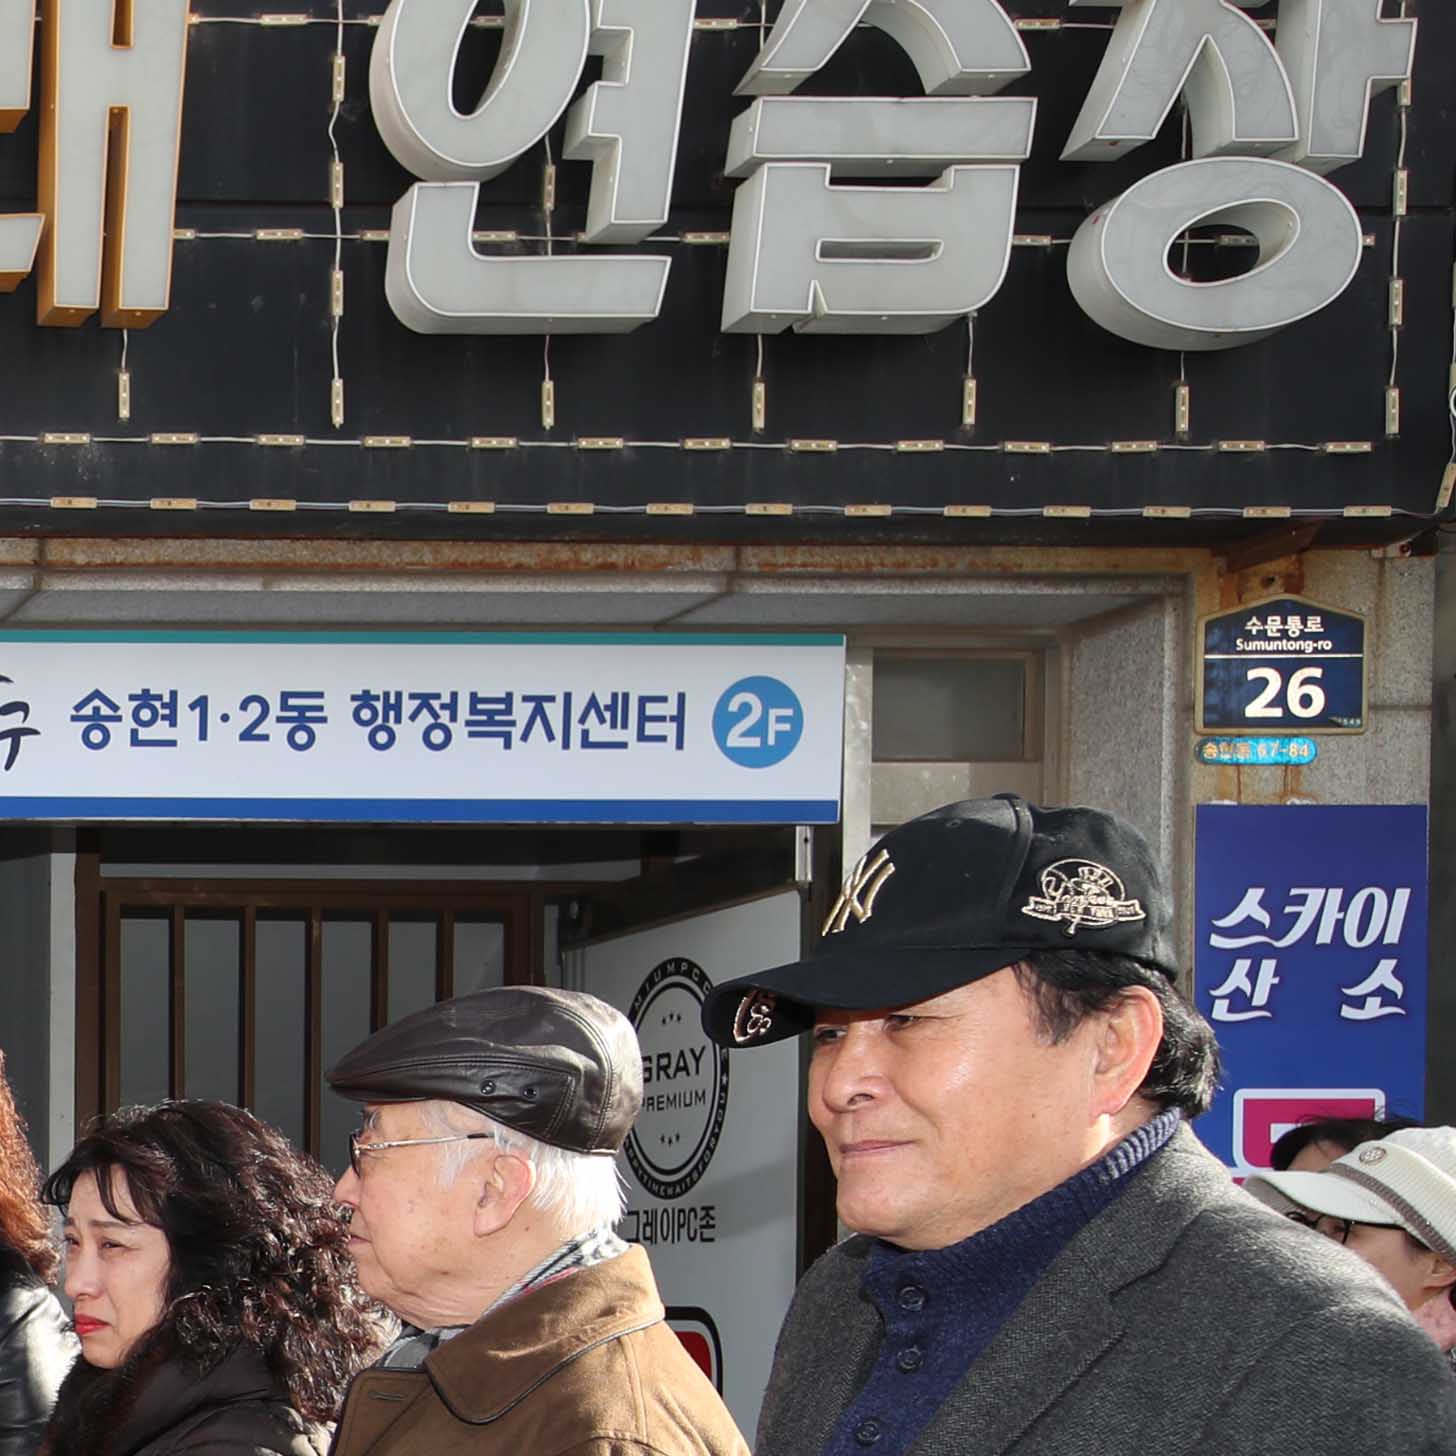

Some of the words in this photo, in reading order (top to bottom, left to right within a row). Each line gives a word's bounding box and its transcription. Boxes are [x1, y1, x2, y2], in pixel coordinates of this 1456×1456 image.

[350, 689, 687, 752] 행정복지센터
[725, 691, 794, 748] 2F
[1244, 667, 1326, 718] 26
[1209, 886, 1411, 949] 스카이
[641, 1046, 706, 1083] GRAY
